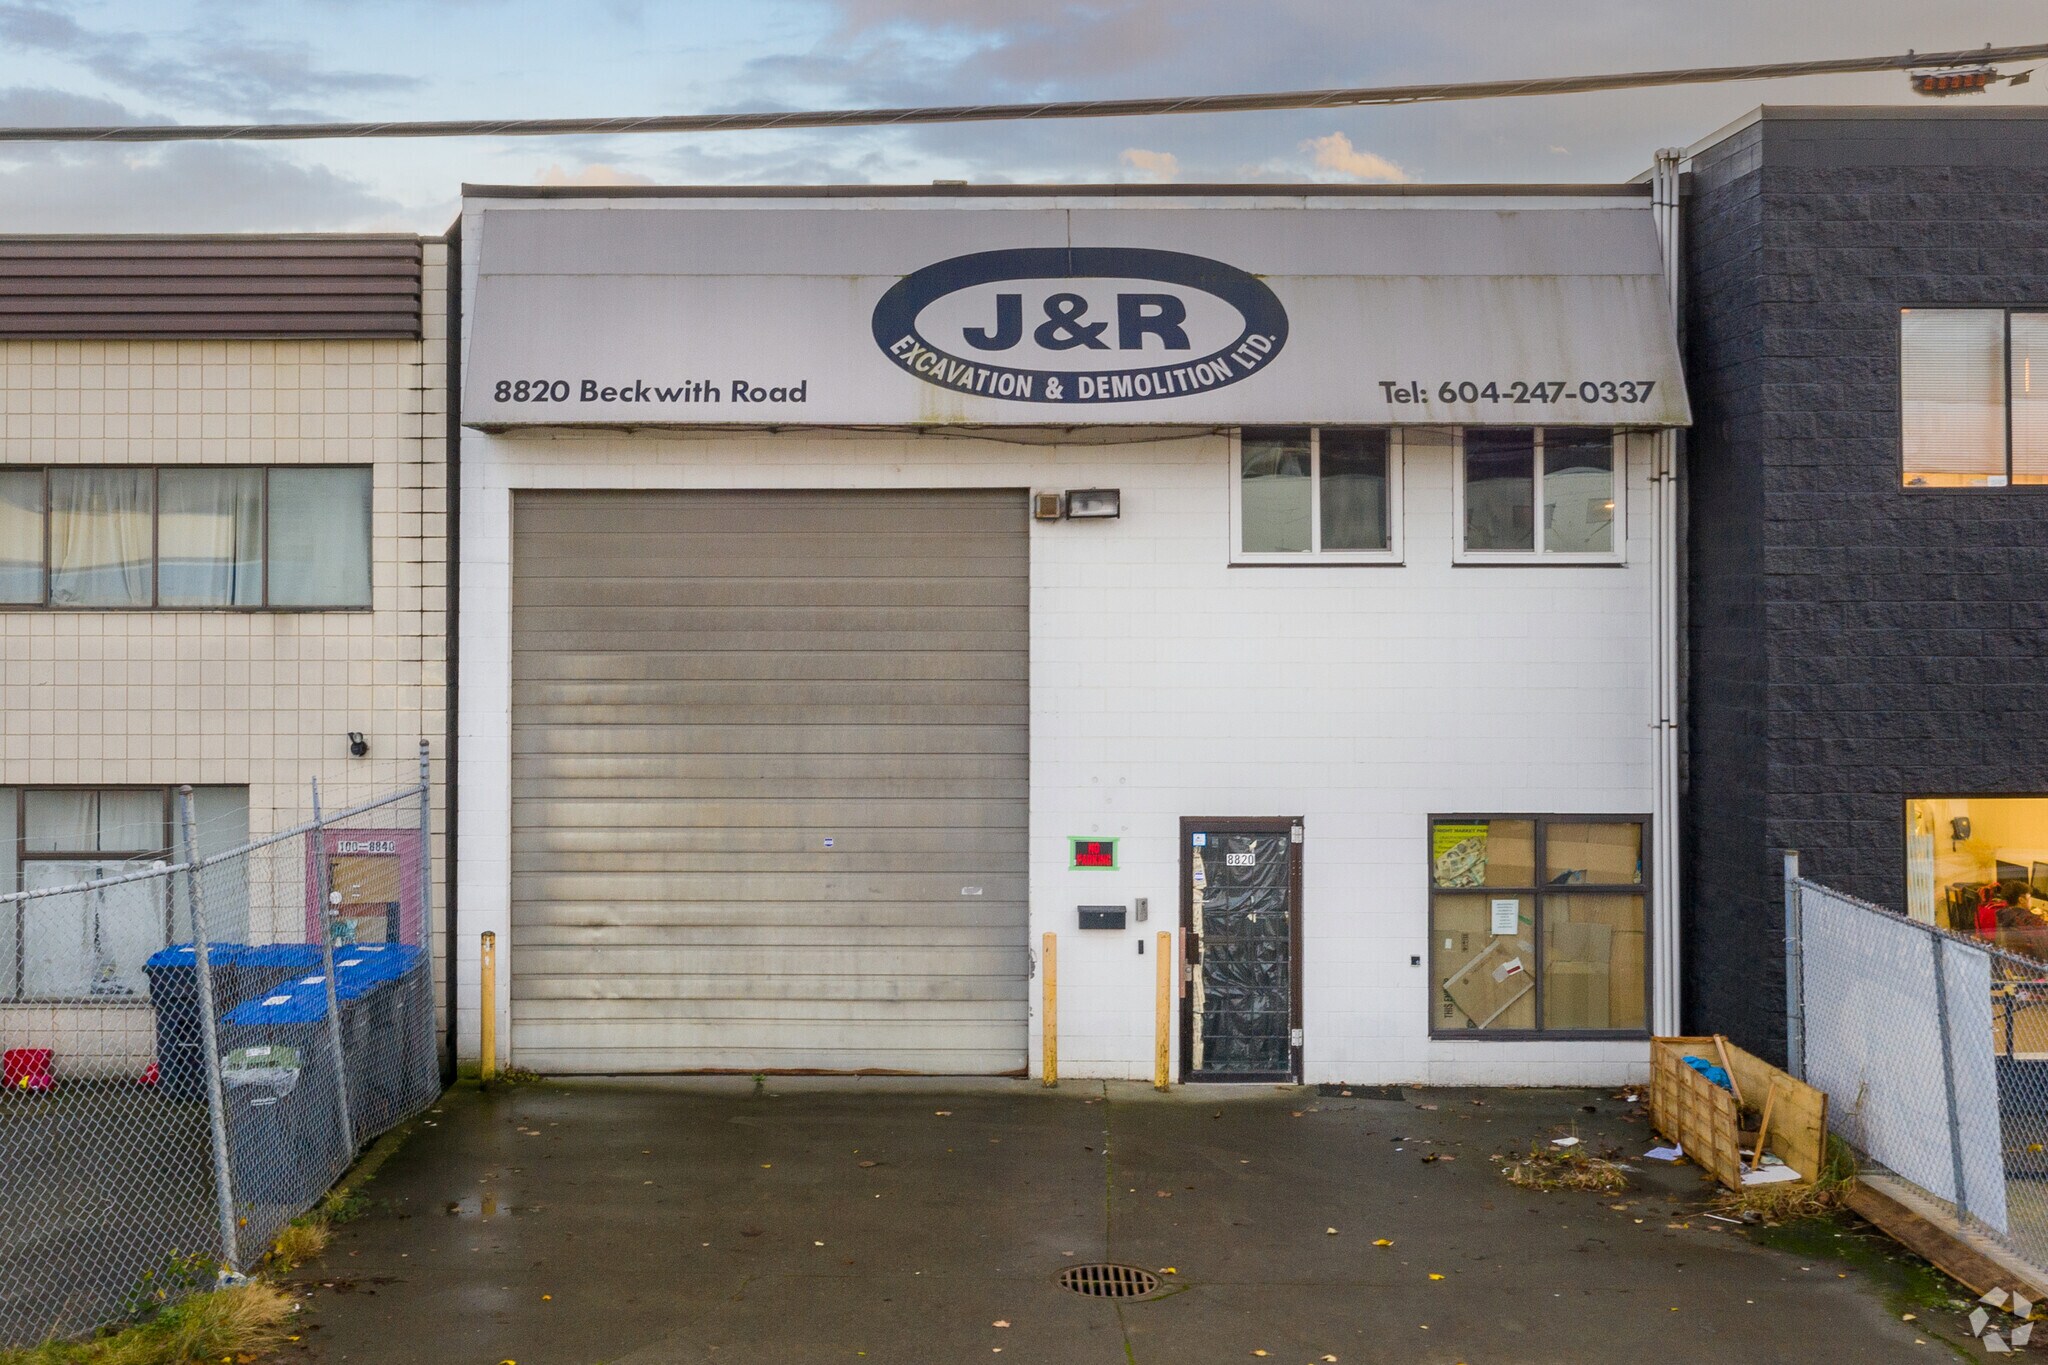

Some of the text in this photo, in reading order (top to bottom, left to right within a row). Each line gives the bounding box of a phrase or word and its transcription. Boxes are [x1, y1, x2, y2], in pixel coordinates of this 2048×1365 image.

[962, 292, 1191, 351] J&R
[889, 332, 1277, 400] EXCAVATION & DEMOLITION LTD.
[494, 379, 807, 403] 8820 Beckwith Road
[1379, 381, 1656, 404] Tel: 604-247-0337
[1088, 841, 1100, 854] NO
[1076, 854, 1111, 866] PARKING
[1227, 854, 1254, 865] 8820
